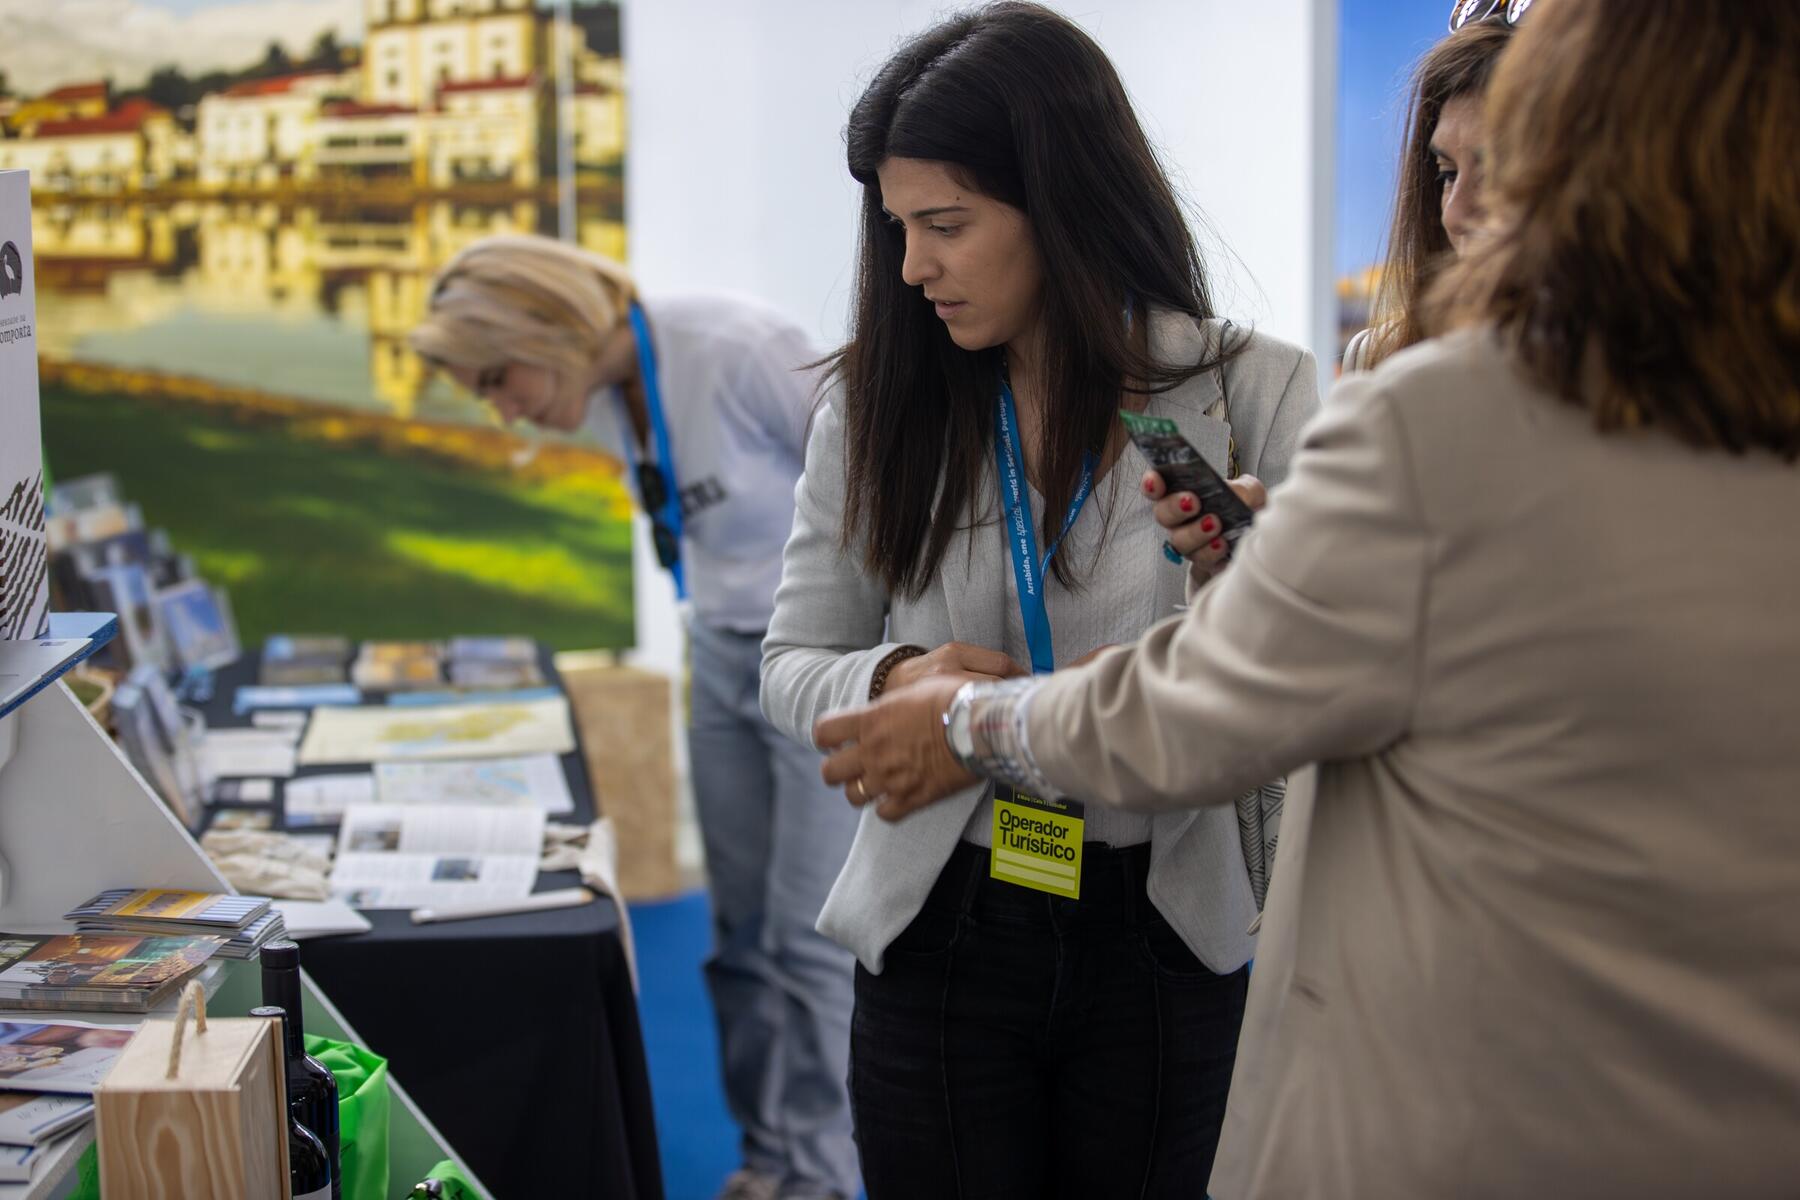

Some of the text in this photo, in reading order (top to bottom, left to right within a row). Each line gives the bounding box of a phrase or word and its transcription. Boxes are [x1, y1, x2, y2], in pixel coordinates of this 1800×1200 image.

[1000, 395, 1009, 432] Portuga
[1008, 468, 1016, 478] in
[1000, 809, 1069, 839] Operador
[1000, 826, 1076, 861] Turístico
